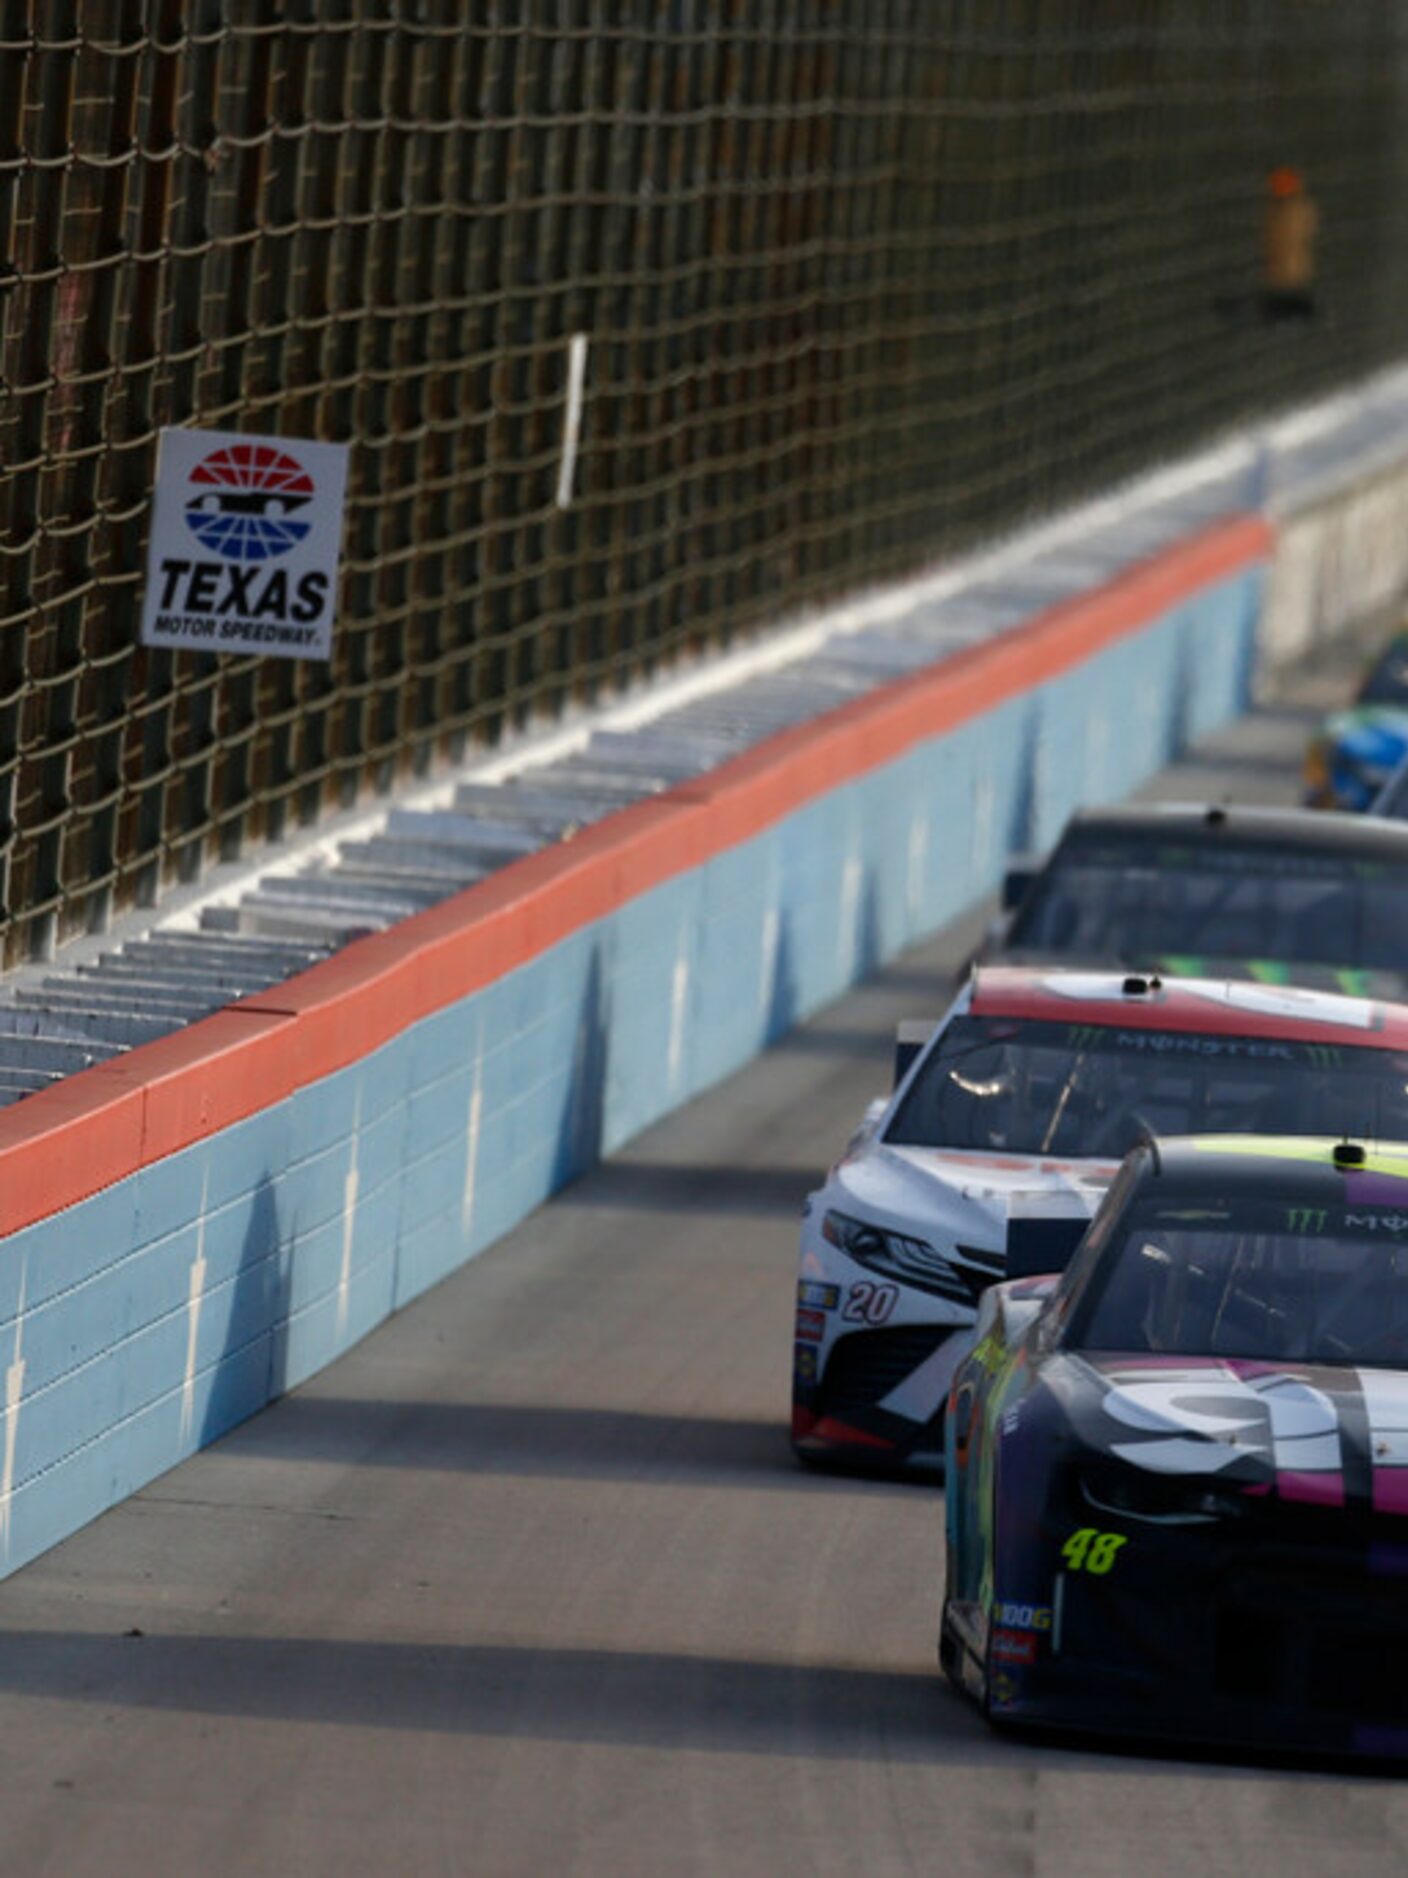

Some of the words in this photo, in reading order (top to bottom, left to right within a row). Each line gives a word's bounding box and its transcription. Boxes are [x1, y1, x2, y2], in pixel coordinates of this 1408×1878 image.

[160, 559, 329, 623] TEXAS
[154, 615, 216, 638] MOTOR
[219, 621, 316, 647] SPEEDWAY
[1116, 1033, 1293, 1060] MONSTER
[842, 1281, 899, 1326] 20
[1060, 1527, 1128, 1575] 48
